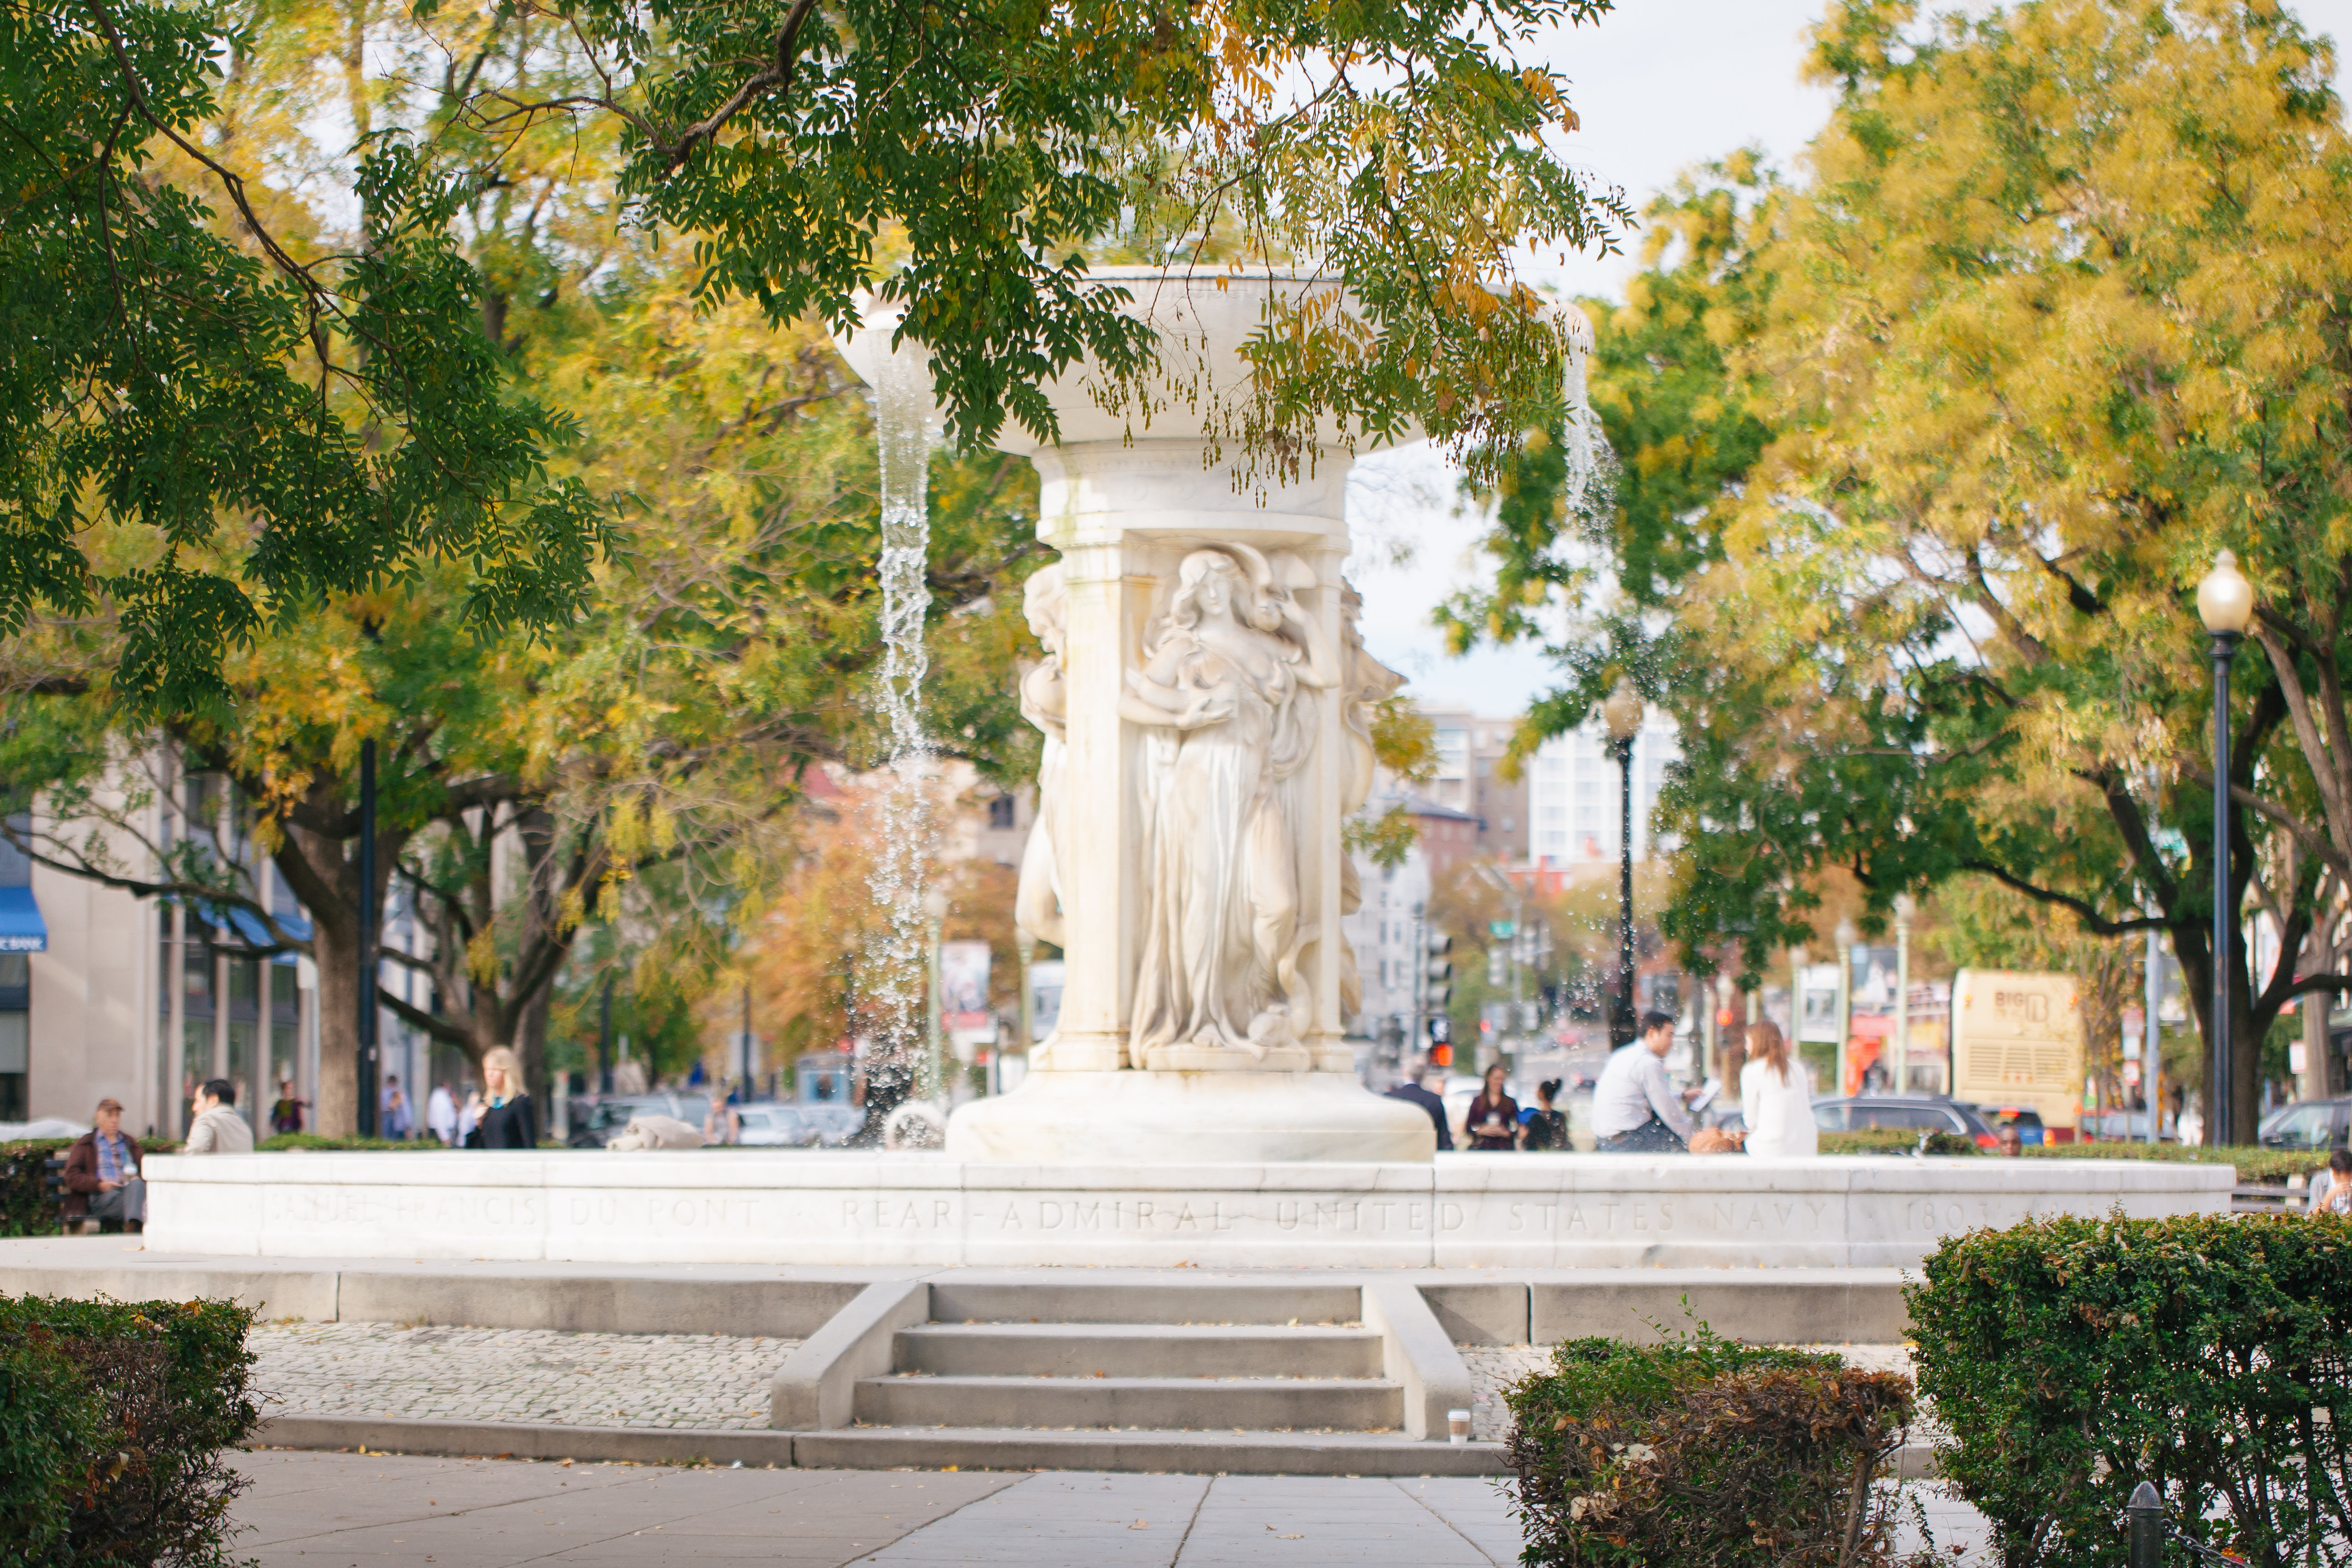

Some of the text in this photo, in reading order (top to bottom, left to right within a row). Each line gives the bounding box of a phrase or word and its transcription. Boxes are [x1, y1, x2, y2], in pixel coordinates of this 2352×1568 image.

[10, 936, 44, 950] BANK
[1995, 992, 2024, 1006] BIG
[398, 1196, 536, 1226] FRANCIS
[570, 1198, 618, 1226] DU
[647, 1199, 760, 1227] PONT
[1276, 1202, 1465, 1232] UNITED
[1508, 1203, 1674, 1233] STATES
[1713, 1202, 1830, 1232] NAVY
